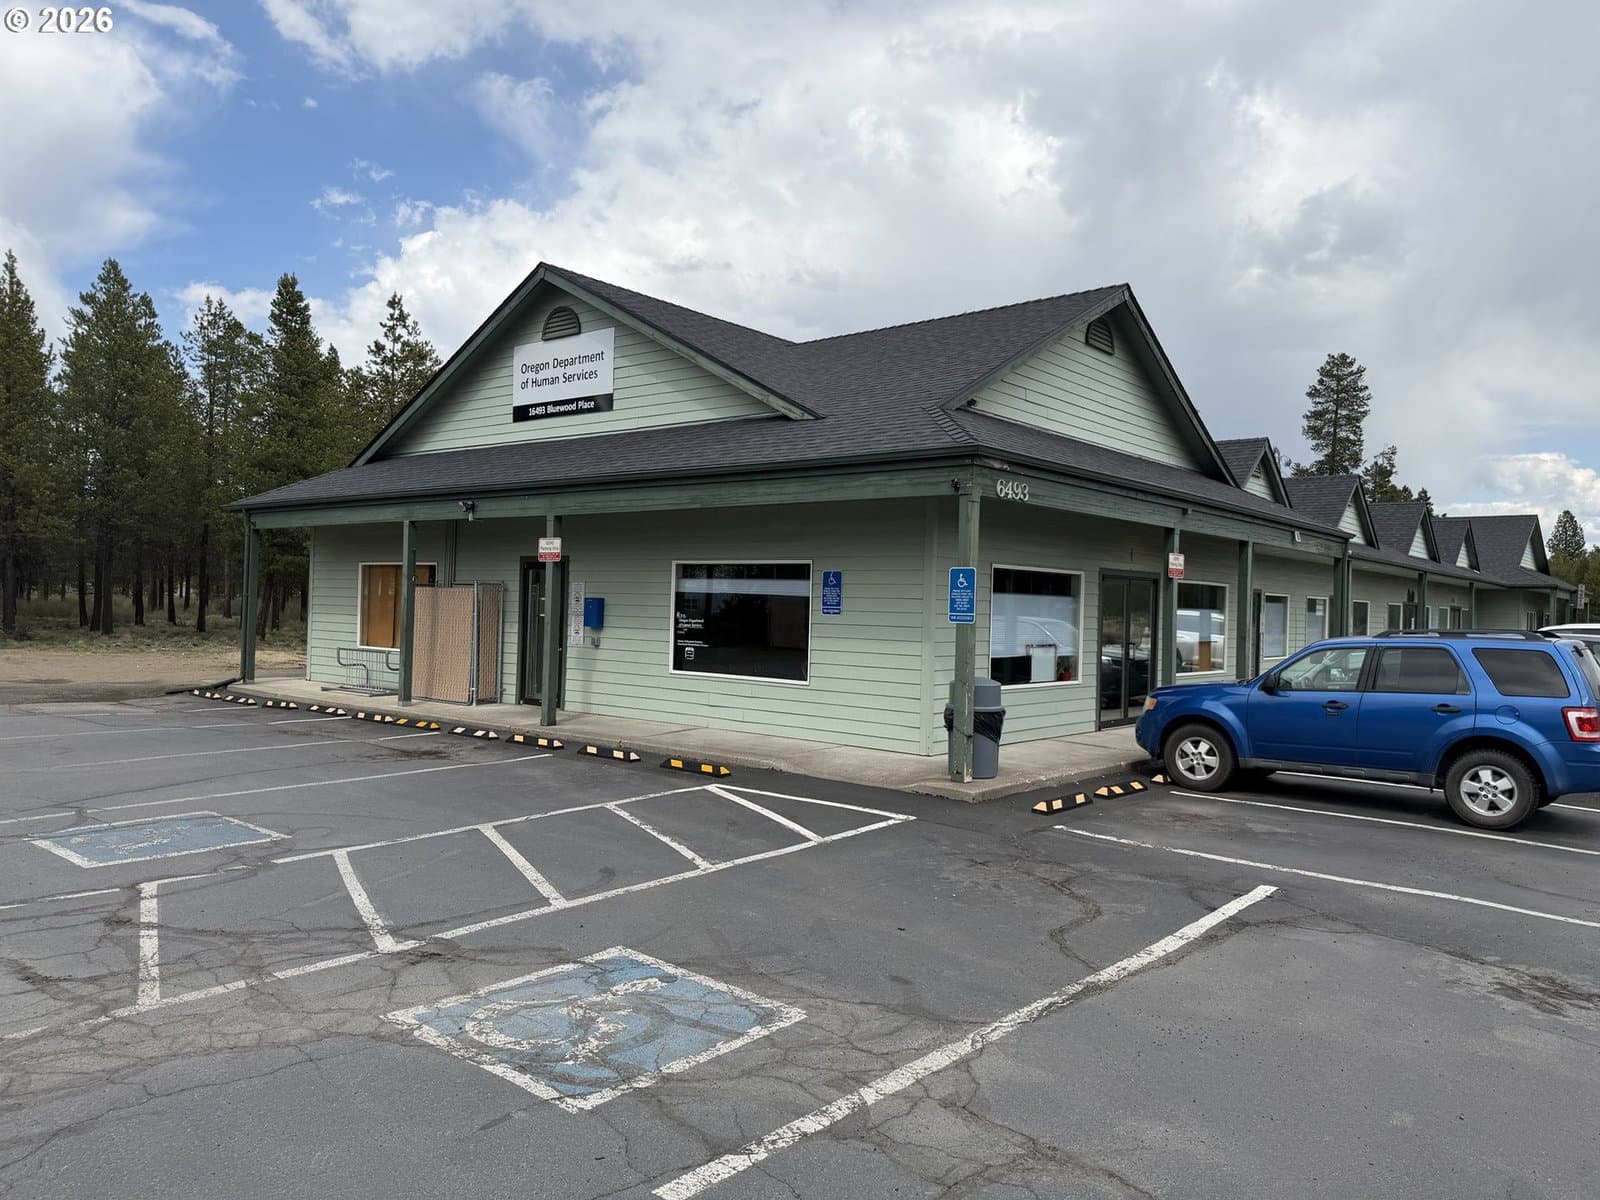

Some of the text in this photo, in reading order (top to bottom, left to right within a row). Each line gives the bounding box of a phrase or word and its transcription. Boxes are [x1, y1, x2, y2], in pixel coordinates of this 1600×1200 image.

[520, 350, 604, 374] Oregon Department
[520, 369, 599, 390] of Human Services
[528, 400, 595, 416] 16493 Bluewood Place
[996, 479, 1029, 501] 6493
